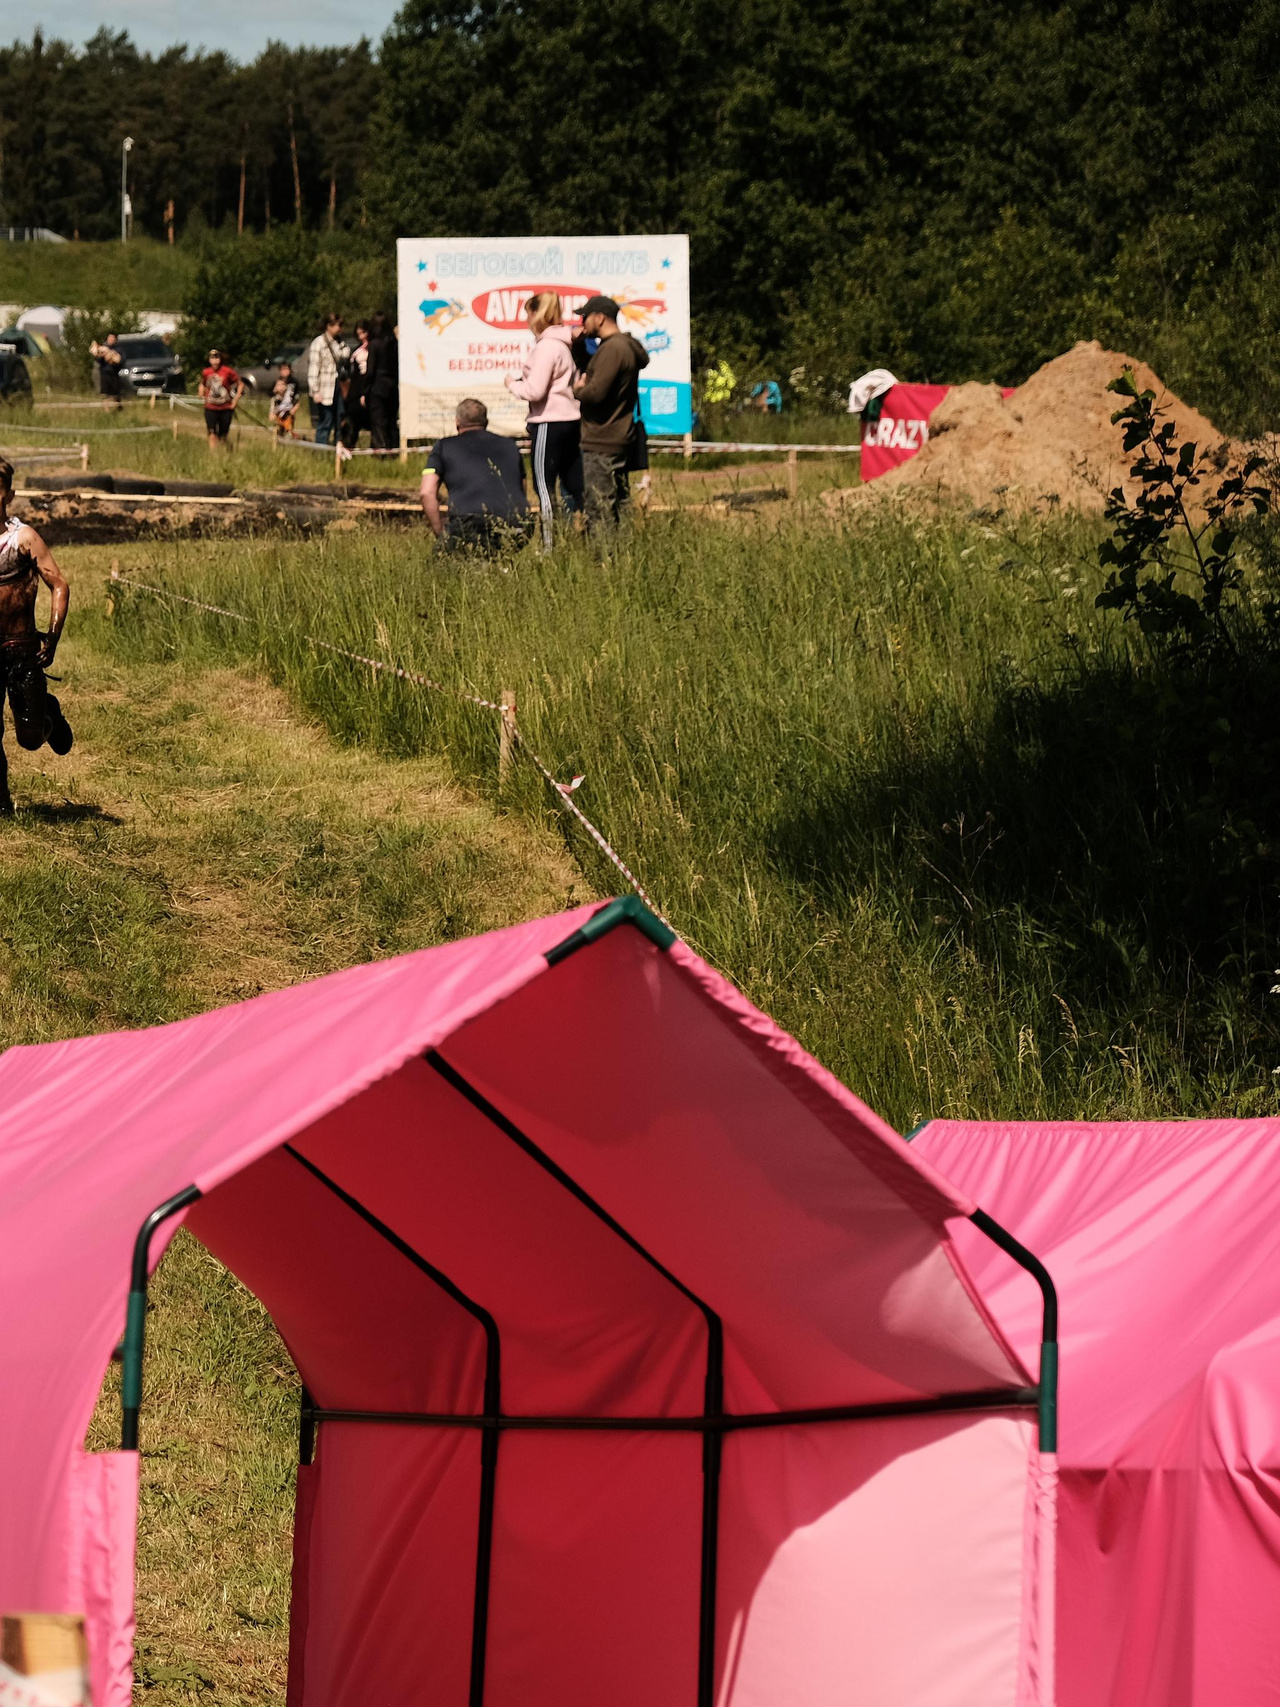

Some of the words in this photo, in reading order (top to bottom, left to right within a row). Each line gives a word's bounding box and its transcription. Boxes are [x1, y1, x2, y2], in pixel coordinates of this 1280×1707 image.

[435, 246, 564, 276] БЕГОВОЙ
[576, 251, 650, 275] КЛУБ
[467, 343, 521, 354] БЕЖИМ
